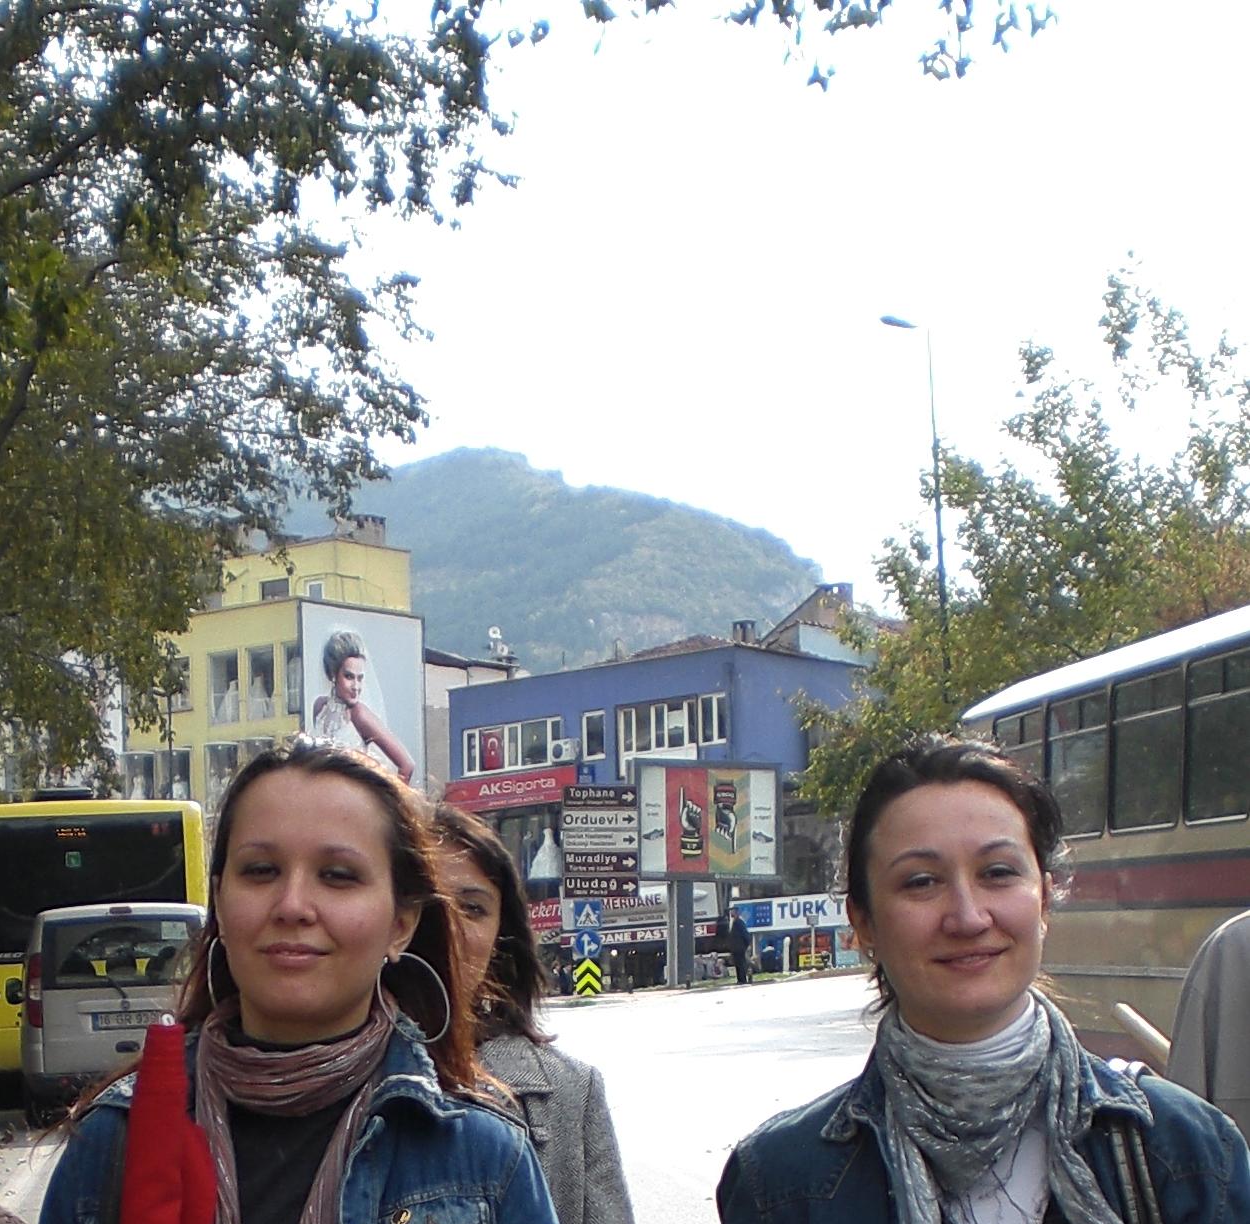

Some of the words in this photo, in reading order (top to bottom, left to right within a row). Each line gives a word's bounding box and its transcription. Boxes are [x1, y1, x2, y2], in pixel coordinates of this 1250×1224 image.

[478, 778, 556, 796] AKSigorta
[569, 788, 615, 800] Tophane
[563, 814, 618, 825] Orduevi
[565, 853, 618, 865] Muradiye
[566, 878, 617, 890] Uludağ
[777, 898, 827, 919] TÜRK
